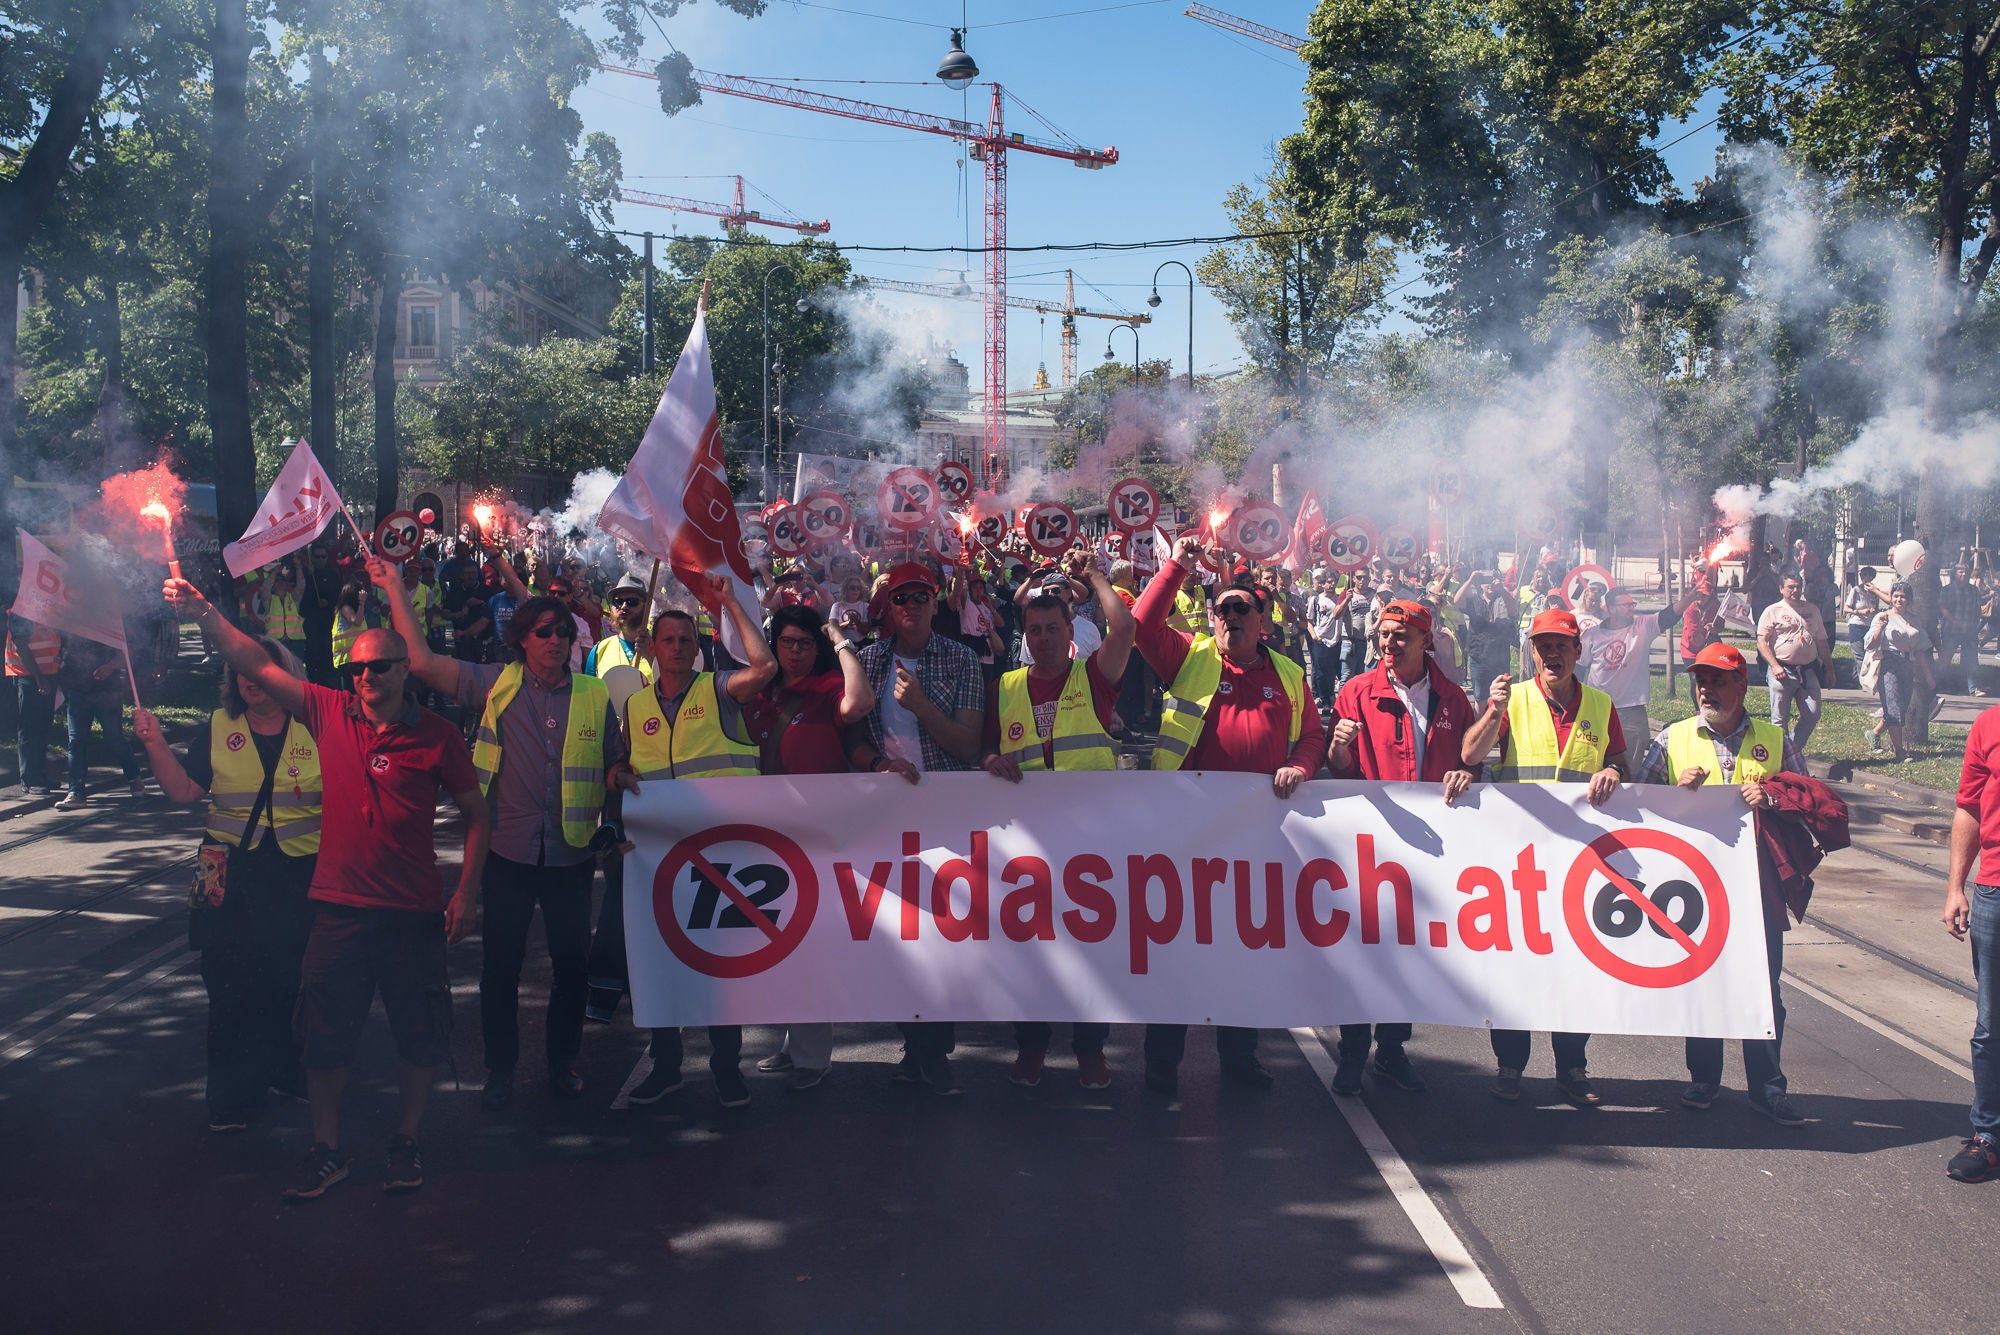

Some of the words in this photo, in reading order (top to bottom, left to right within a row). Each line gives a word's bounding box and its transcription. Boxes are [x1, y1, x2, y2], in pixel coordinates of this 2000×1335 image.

[937, 477, 967, 494] 60
[892, 484, 930, 512] 12
[1118, 491, 1150, 519] 12
[806, 506, 842, 532] 60
[1036, 514, 1068, 540] 12
[383, 525, 418, 549] 60
[1240, 519, 1280, 544] 60
[1331, 534, 1368, 558] 60
[1386, 537, 1416, 558] 12
[1220, 682, 1232, 692] 12
[683, 704, 704, 717] vida
[578, 723, 597, 738] vida
[1011, 726, 1022, 737] 12
[1436, 717, 1452, 730] vida
[1576, 729, 1599, 742] vida
[290, 742, 312, 757] vida
[1755, 748, 1766, 758] 12
[1742, 768, 1765, 782] vida
[687, 862, 790, 930] 12
[833, 830, 1554, 975] vidaspruch.at
[1592, 878, 1704, 940] 60
